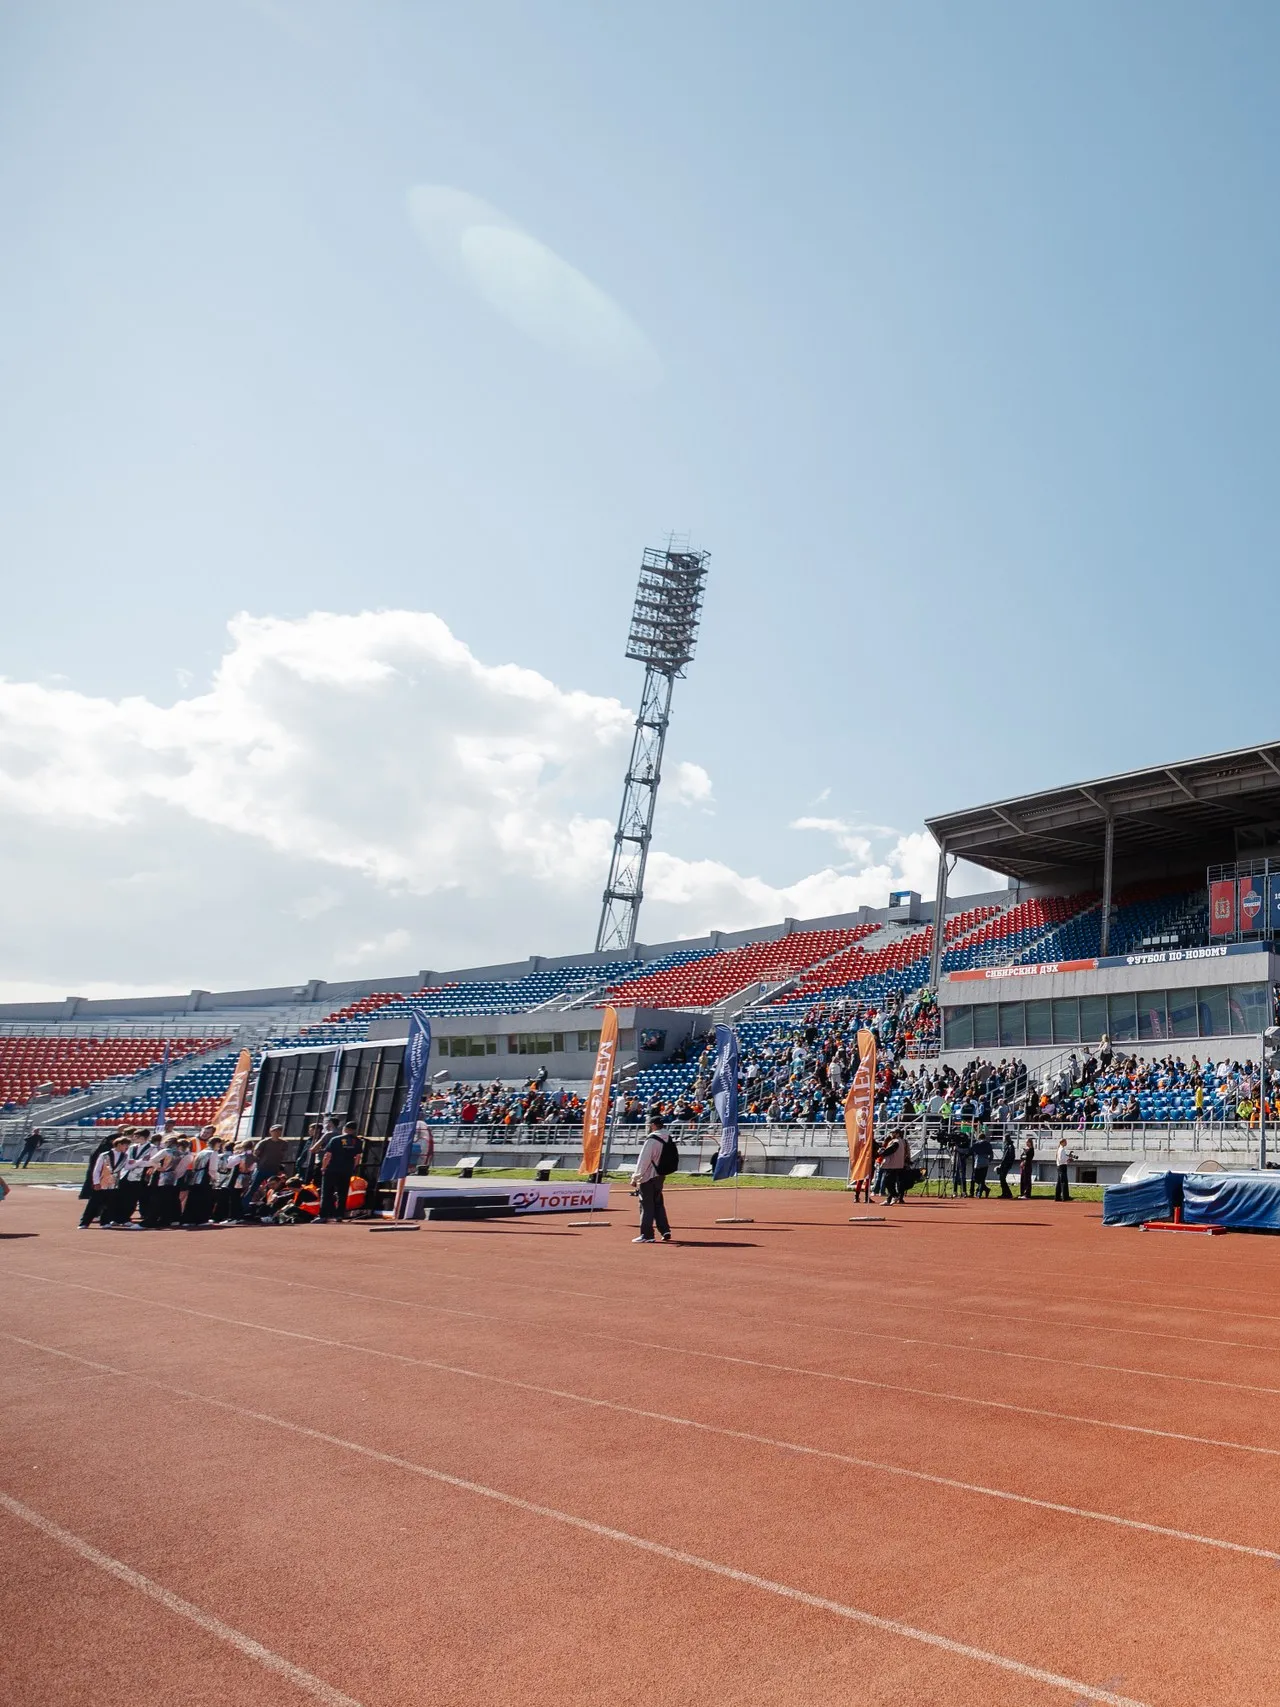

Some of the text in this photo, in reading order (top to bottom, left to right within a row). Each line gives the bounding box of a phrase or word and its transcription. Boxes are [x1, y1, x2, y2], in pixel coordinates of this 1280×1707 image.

[1126, 947, 1228, 965] ФУТБОЛ ПО-НОВОМУ
[985, 964, 1059, 978] СИБИРСКИЙ ДУХ
